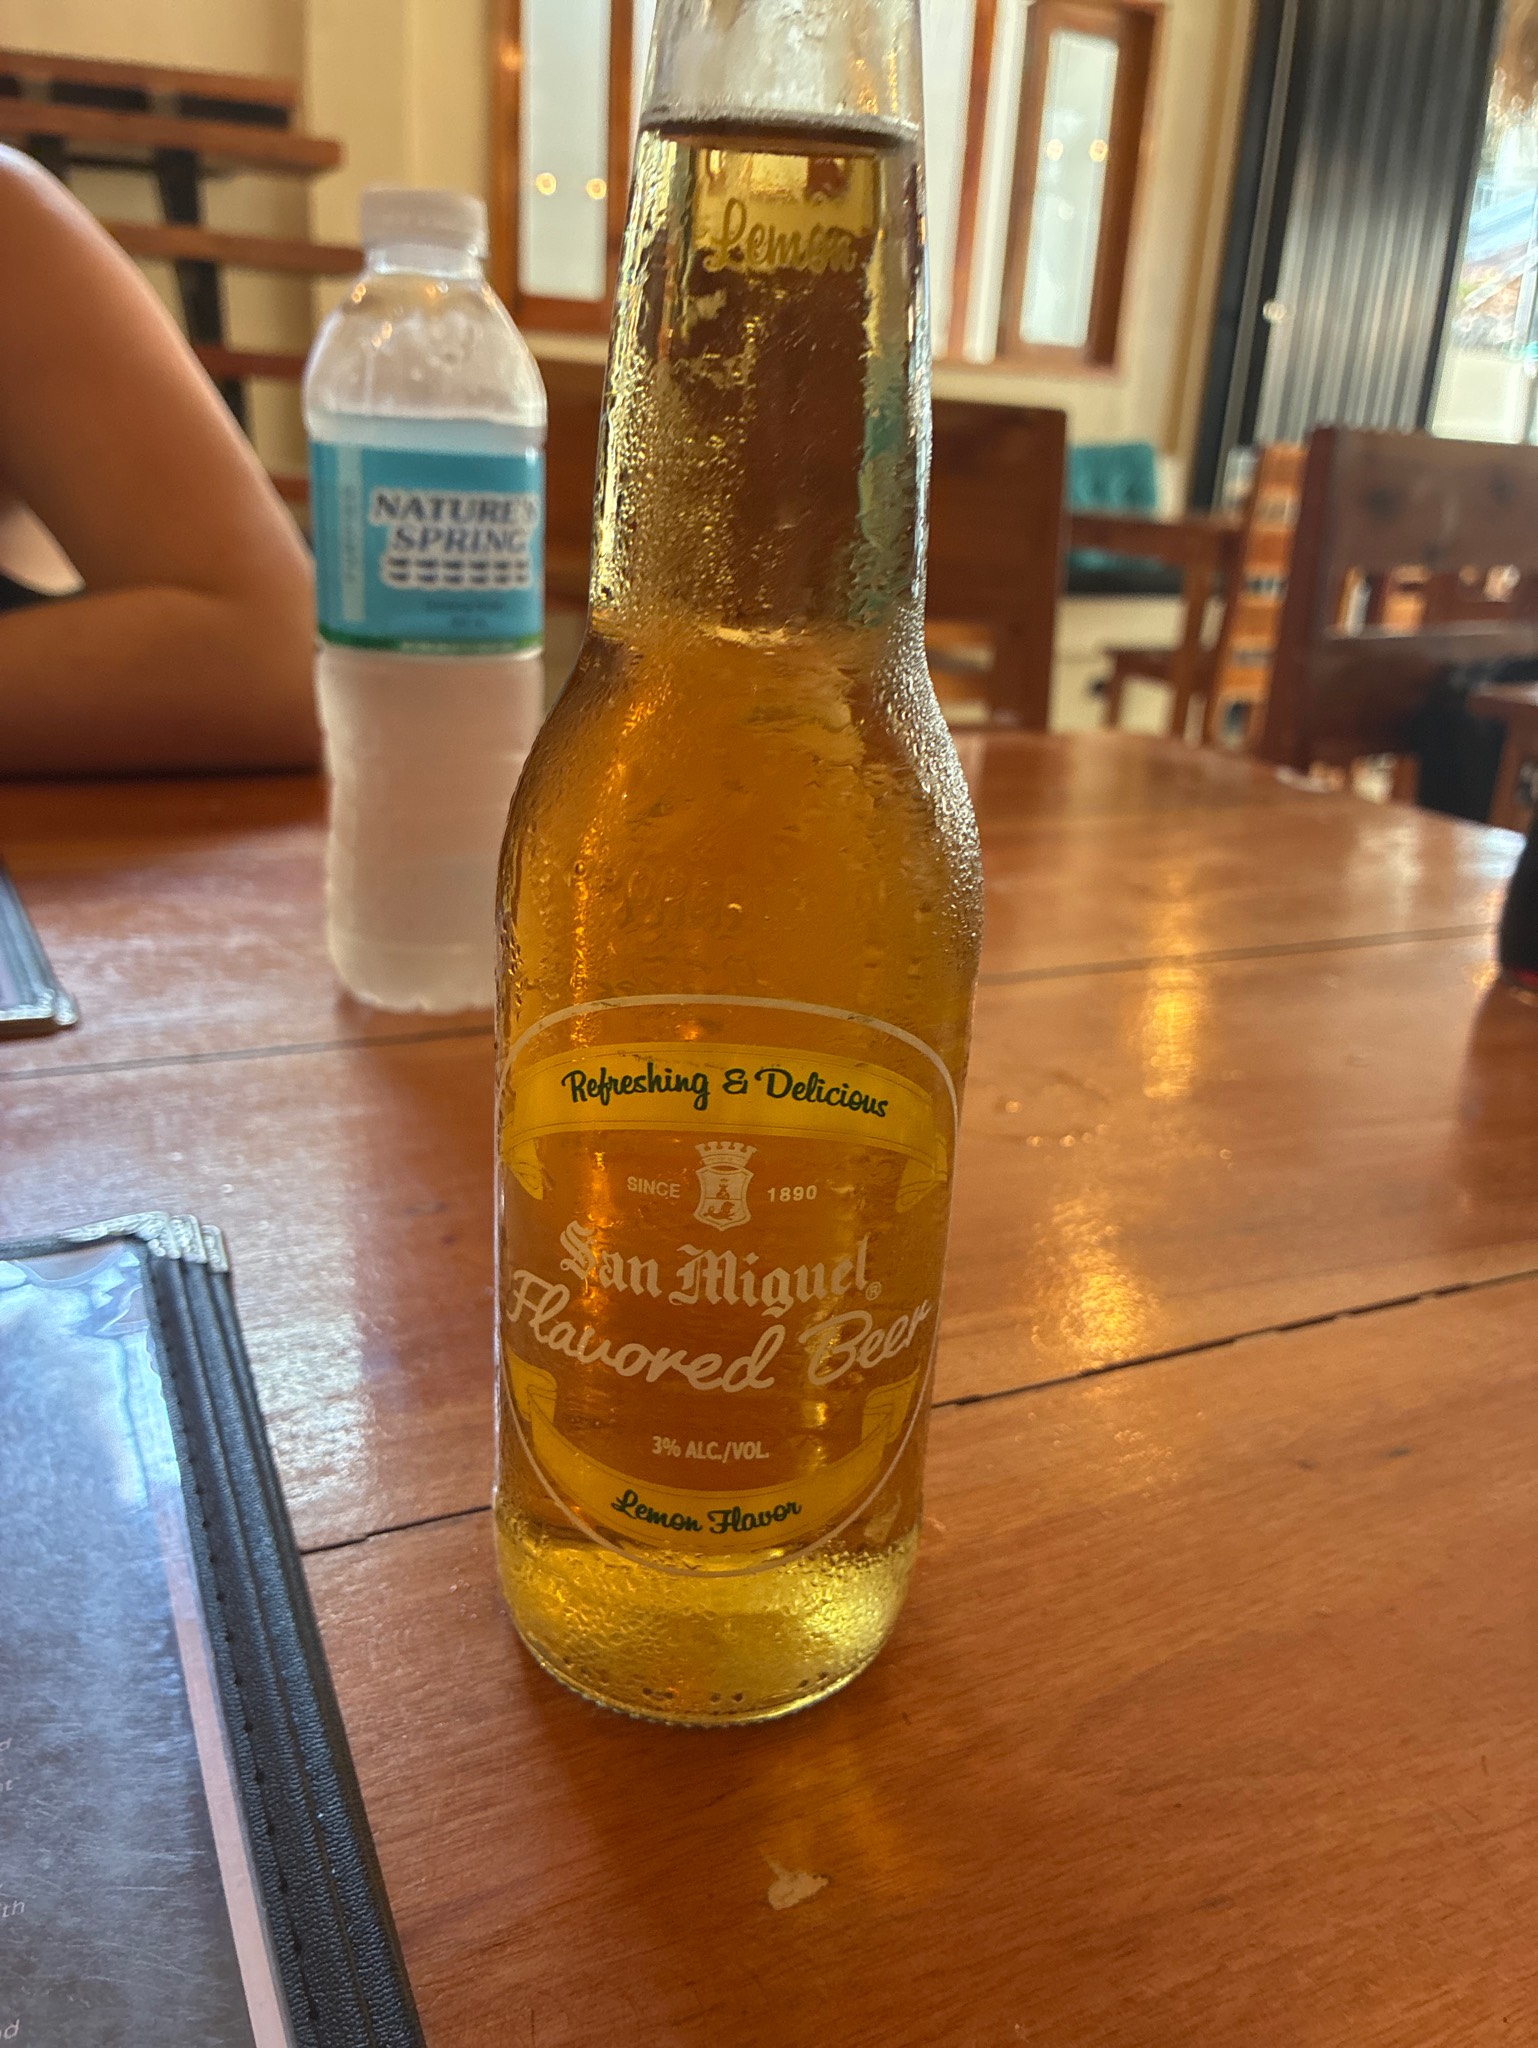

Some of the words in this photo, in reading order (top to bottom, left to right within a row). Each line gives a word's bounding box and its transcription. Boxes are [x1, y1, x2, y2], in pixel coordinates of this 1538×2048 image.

[392, 524, 527, 554] SPRING
[561, 1062, 710, 1111] Refreshing
[722, 1067, 749, 1095] &
[754, 1067, 889, 1118] Delicious
[626, 1175, 681, 1199] SINCE
[767, 1185, 818, 1202] 1890
[559, 1220, 662, 1298] San
[507, 1269, 786, 1393] Flavored
[798, 1299, 933, 1386] Beer
[652, 1435, 682, 1458] 3%
[611, 1489, 703, 1533] Lemon
[708, 1500, 803, 1535] Flavor
